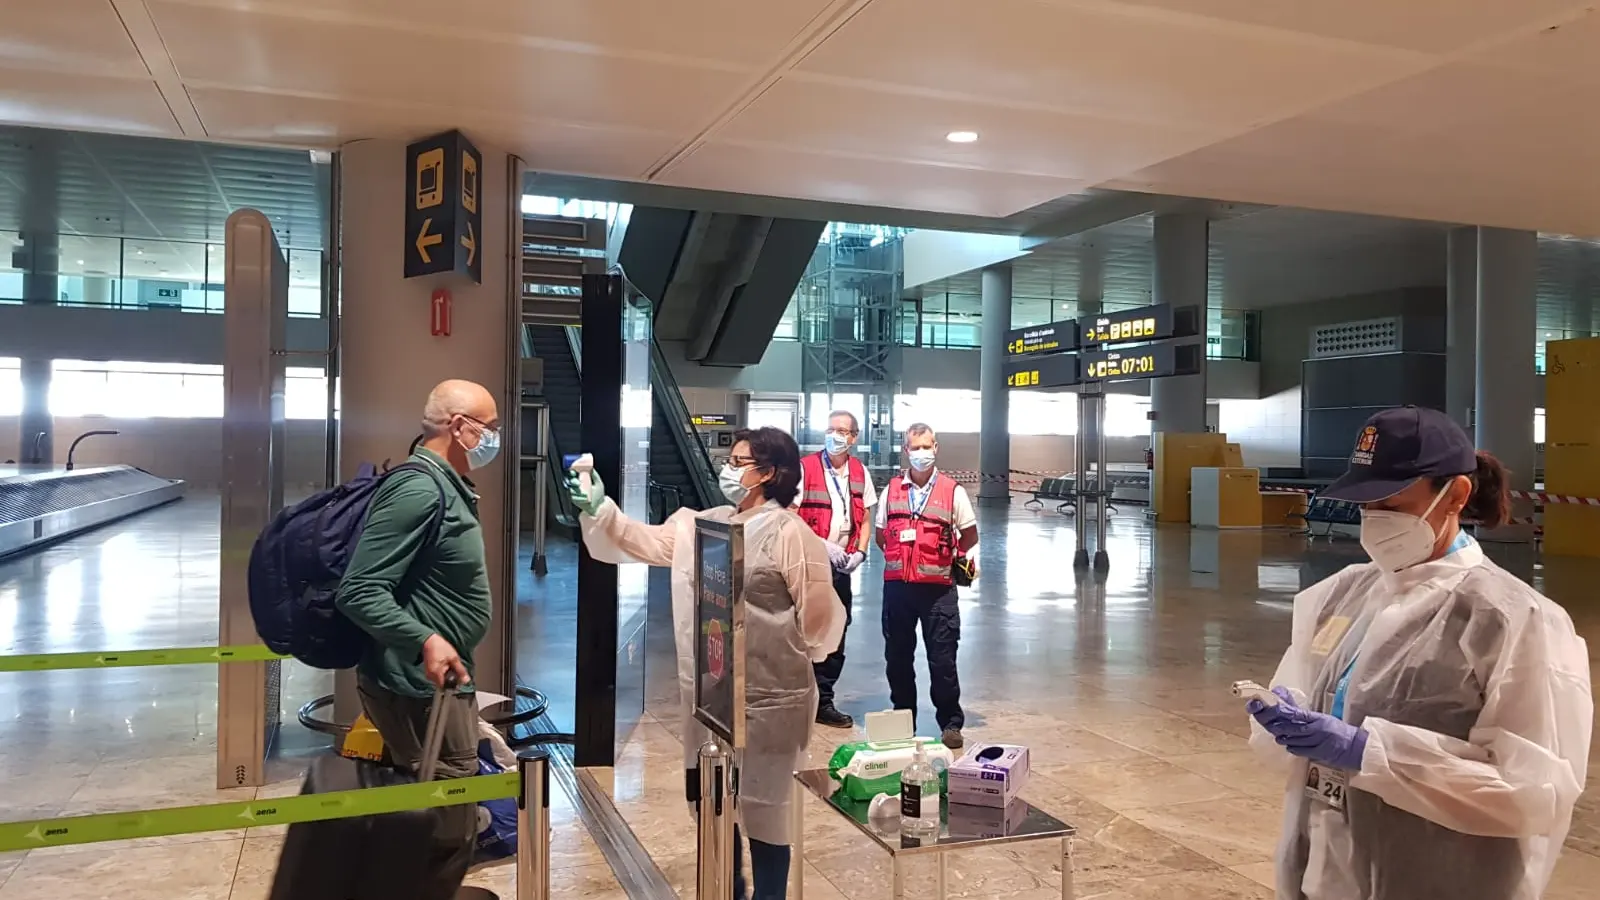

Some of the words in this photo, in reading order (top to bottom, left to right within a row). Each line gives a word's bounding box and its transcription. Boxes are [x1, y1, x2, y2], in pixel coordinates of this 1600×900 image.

[1121, 356, 1154, 374] 07:01
[708, 633, 722, 662] STOP
[864, 761, 888, 771] clinell
[447, 787, 466, 796] aena
[1323, 781, 1342, 801] 24
[255, 807, 277, 816] aena
